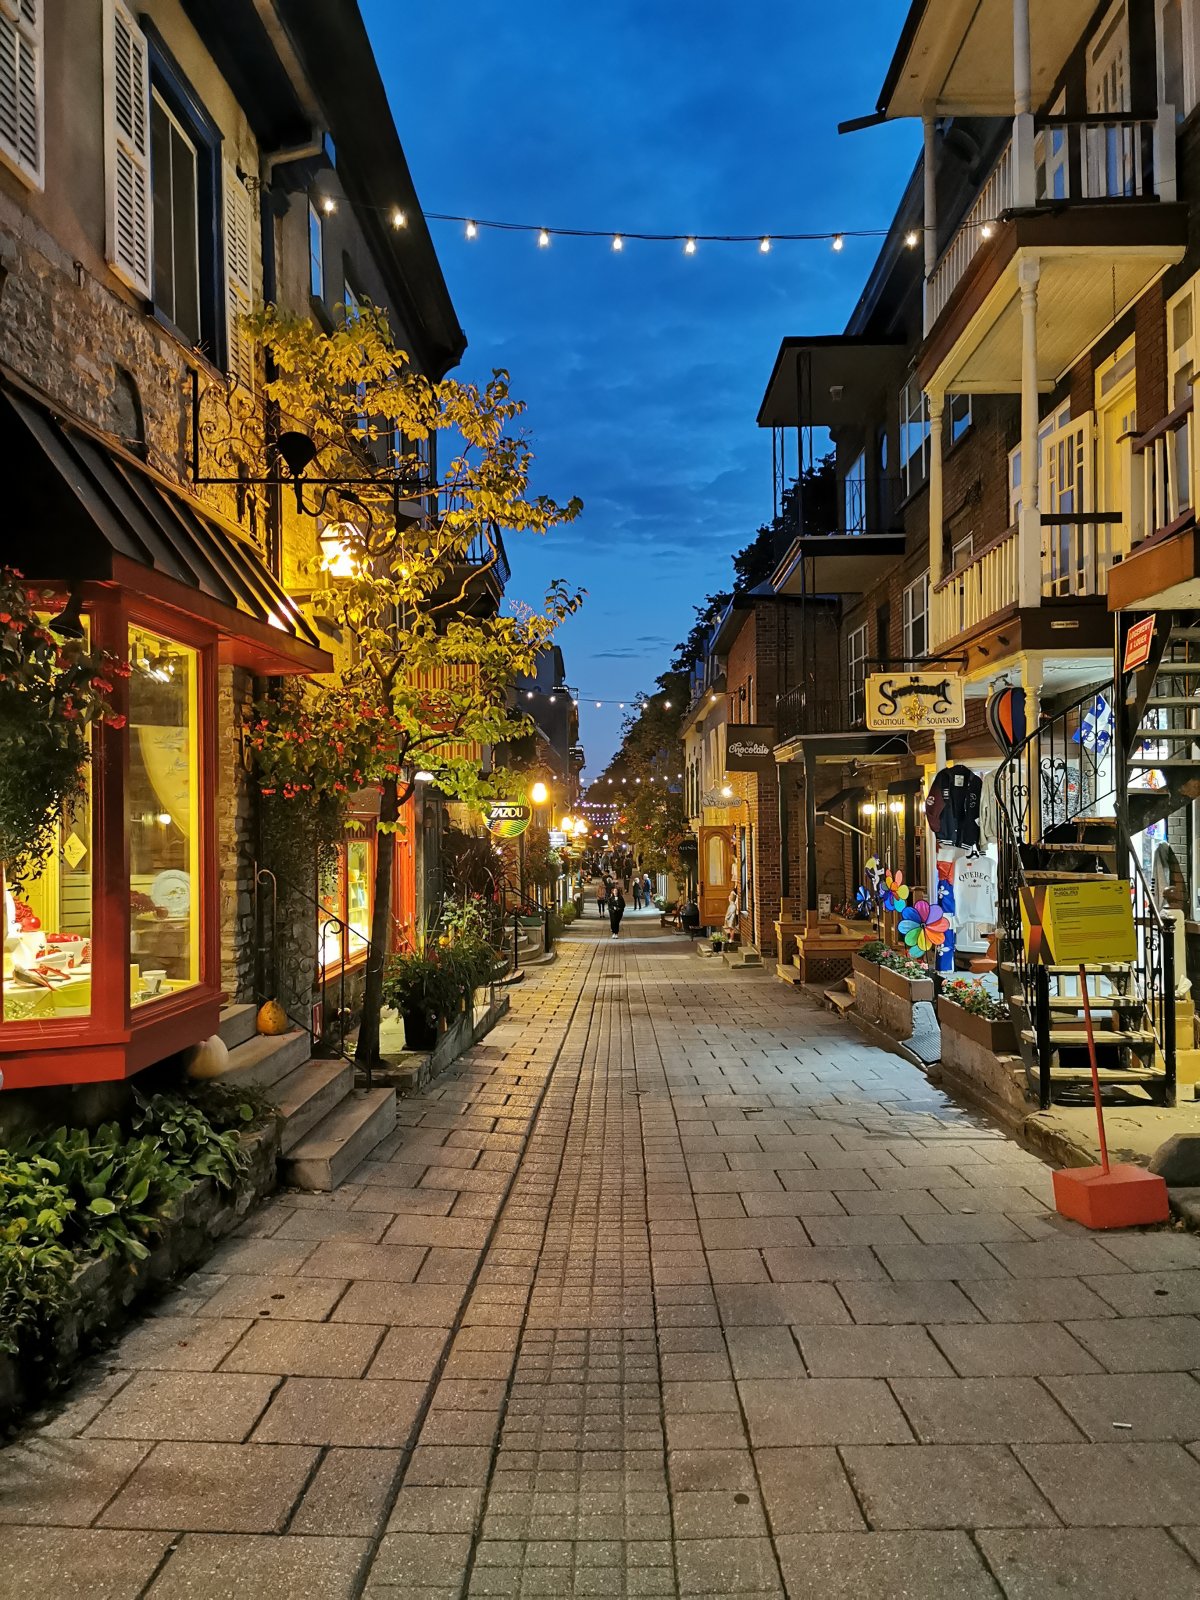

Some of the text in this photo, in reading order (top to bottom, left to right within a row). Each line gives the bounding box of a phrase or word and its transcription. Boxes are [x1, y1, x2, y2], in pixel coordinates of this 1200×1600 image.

[873, 717, 960, 726] BOUTIQUE SOUVENIRS
[728, 741, 770, 758] Chocolato
[490, 807, 523, 818] ZAZOU
